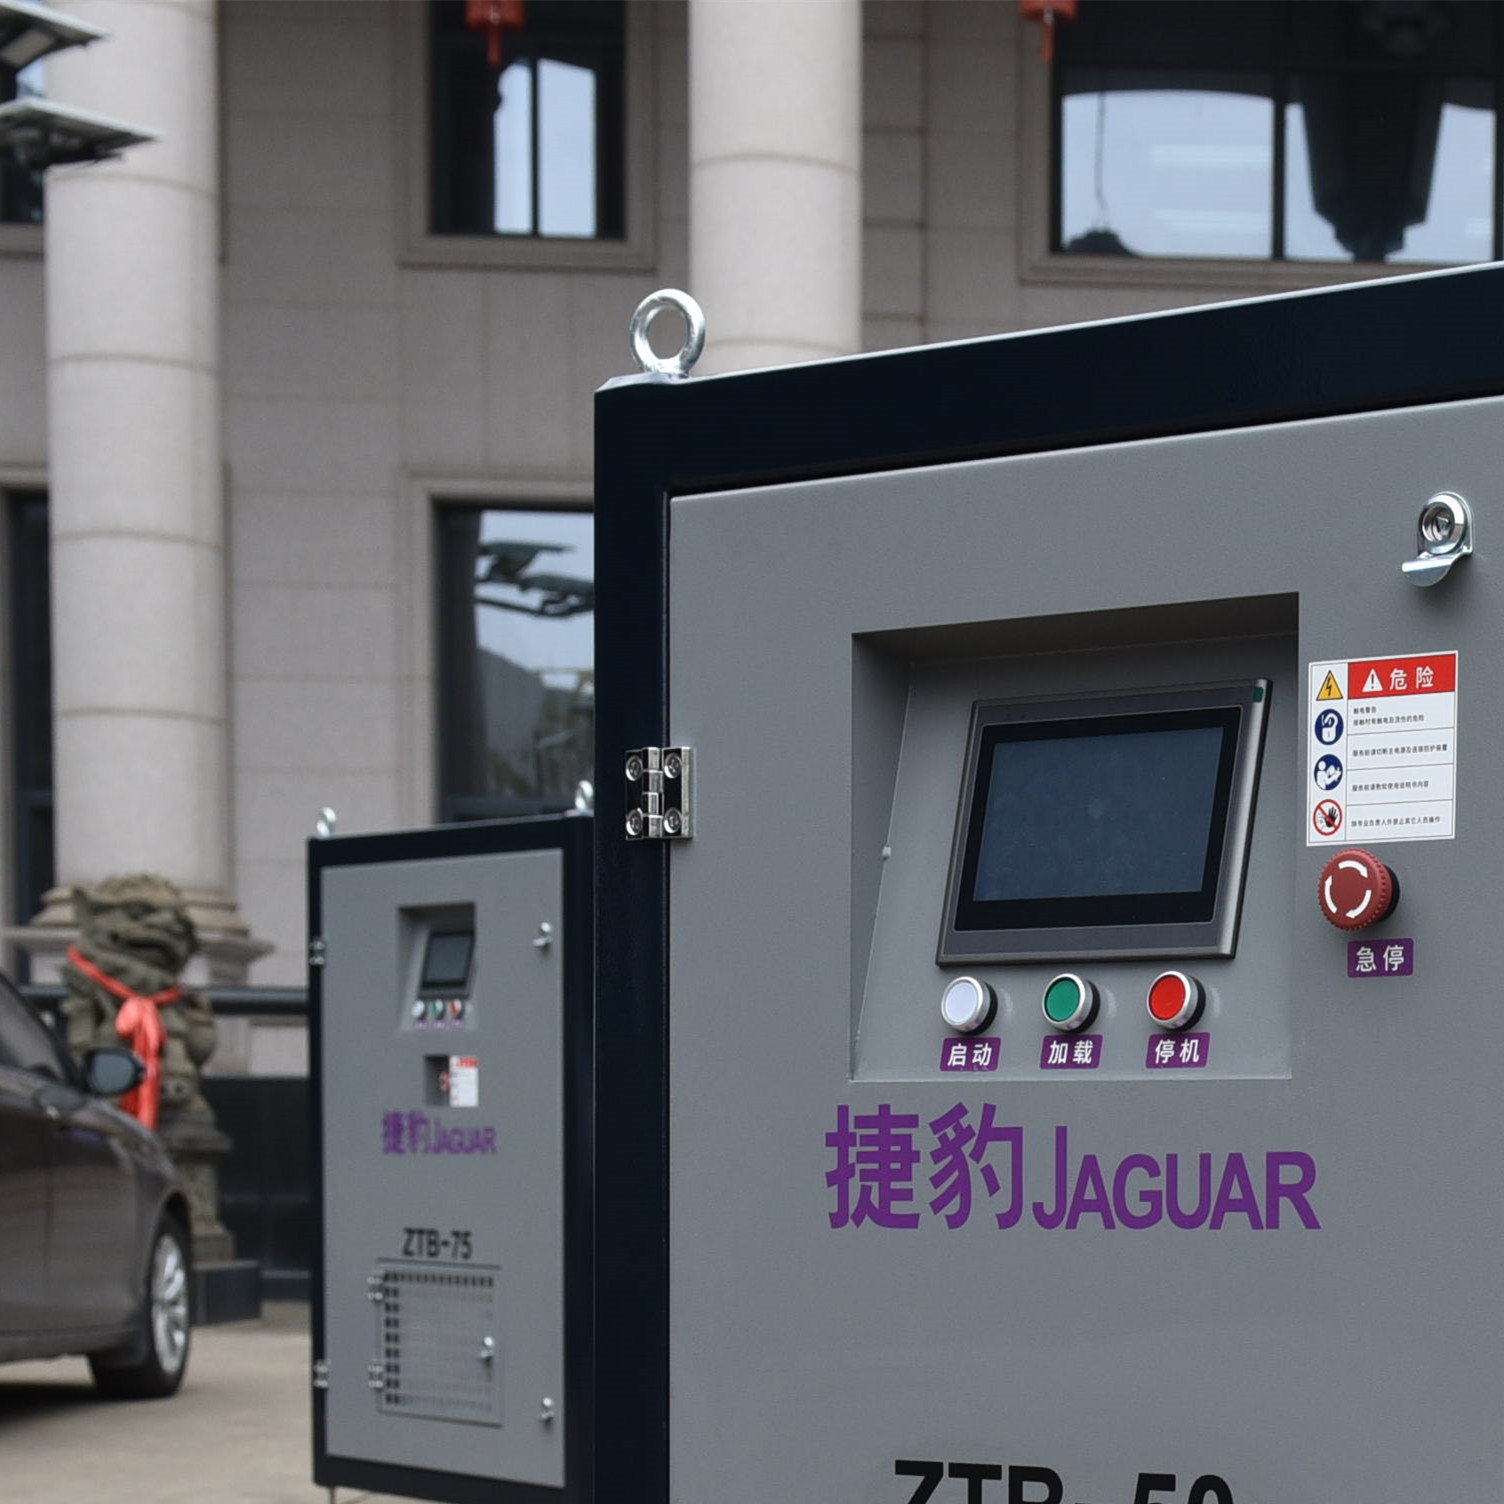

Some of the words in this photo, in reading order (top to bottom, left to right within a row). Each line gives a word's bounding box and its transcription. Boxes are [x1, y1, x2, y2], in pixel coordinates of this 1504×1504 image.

[1389, 665, 1435, 690] 危险
[1356, 945, 1405, 972] 急停
[947, 1043, 993, 1067] 启动
[1048, 1040, 1094, 1065] 加载
[1154, 1038, 1201, 1064] 停机
[1032, 1125, 1322, 1230] JAGUAR
[403, 1227, 473, 1260] ZTB-75
